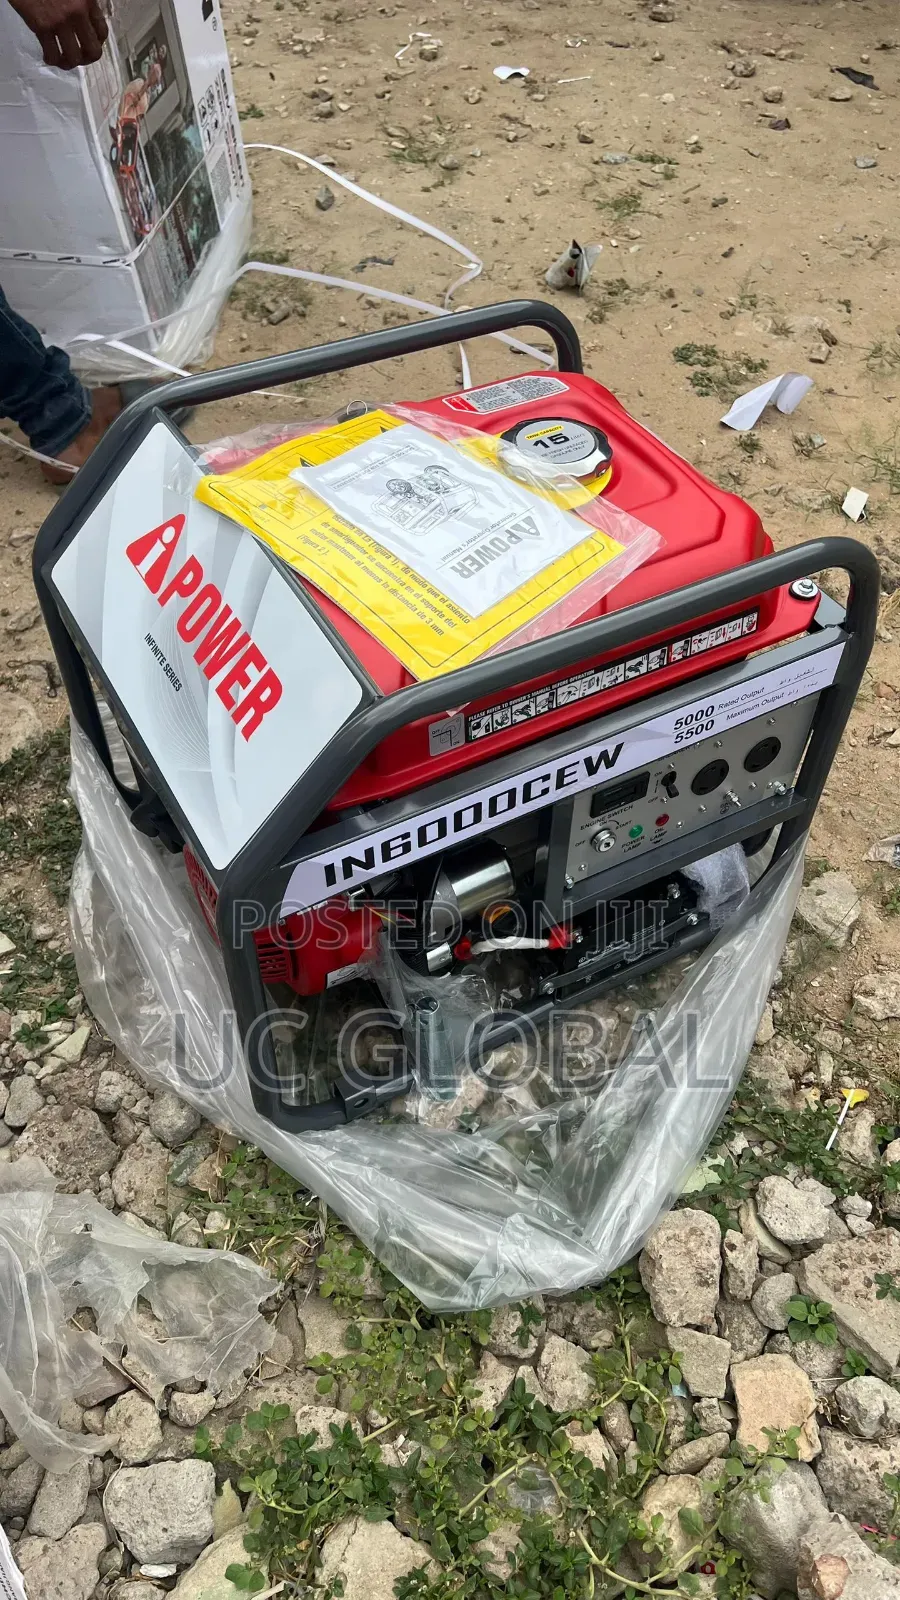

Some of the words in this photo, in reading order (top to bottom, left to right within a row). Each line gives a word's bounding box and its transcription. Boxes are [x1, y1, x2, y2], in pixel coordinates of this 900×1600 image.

[533, 433, 570, 448] 15
[490, 512, 517, 529] Generator
[462, 528, 491, 548] Operator's
[440, 546, 463, 562] Manual
[326, 539, 356, 560] mantener
[361, 566, 382, 584] menos
[389, 587, 418, 612] distancia
[416, 610, 426, 620] de
[425, 617, 433, 625] 3
[367, 554, 376, 562] se
[375, 562, 406, 587] encuentra
[405, 586, 414, 594] en
[413, 592, 422, 600] el
[421, 598, 445, 619] soporte
[444, 617, 458, 628] del
[400, 566, 410, 574] de
[409, 573, 428, 588] modo
[426, 586, 440, 598] que
[438, 596, 448, 604] el
[446, 603, 470, 624] asiento
[144, 632, 166, 666] INFINITE
[163, 663, 182, 692] SERIES
[468, 712, 486, 721] PLEASE
[486, 706, 501, 714] REFER
[532, 686, 551, 697] MANUAL
[552, 680, 568, 690] BEFORE
[570, 670, 595, 683] OPERATION
[674, 706, 714, 730] 5000
[718, 696, 740, 710] Rated
[740, 687, 764, 701] Output
[674, 720, 714, 744] 5500
[726, 704, 760, 721] Maximum
[762, 692, 784, 706] Output
[648, 796, 658, 804] OFF
[324, 742, 625, 888] IN6000CEW
[580, 813, 606, 830] ENGINE
[606, 804, 634, 820] SWITCH
[615, 820, 632, 830] START
[621, 836, 645, 848] POWER
[623, 842, 641, 853] LAMP
[650, 831, 667, 841] LAMP
